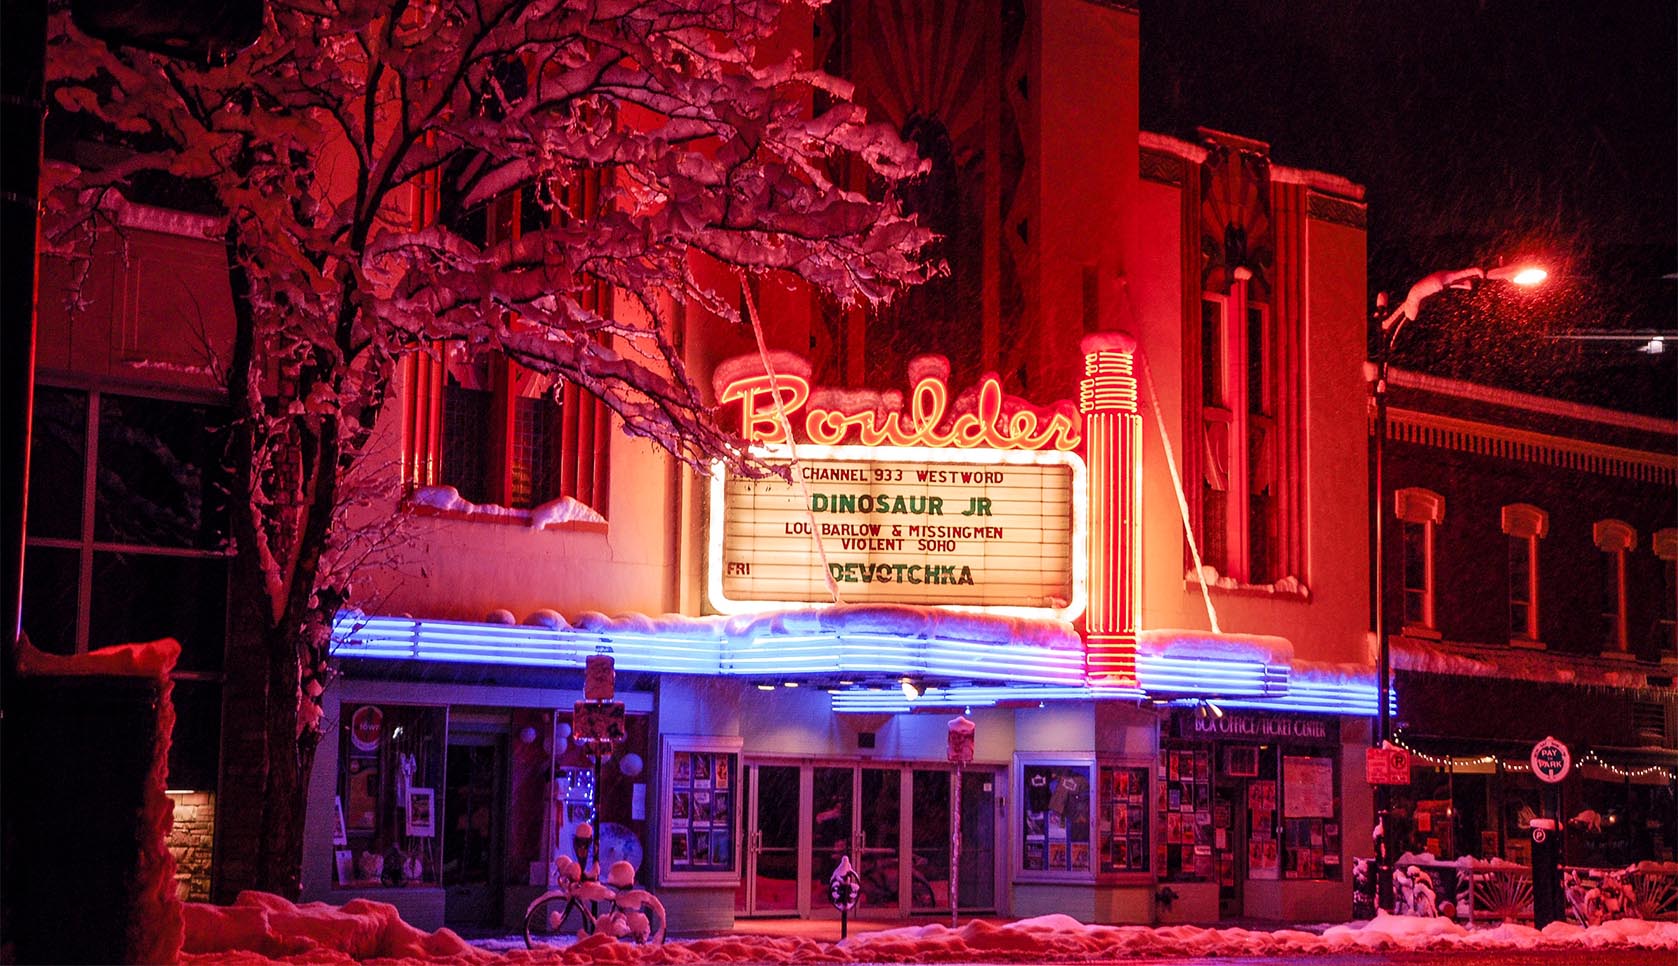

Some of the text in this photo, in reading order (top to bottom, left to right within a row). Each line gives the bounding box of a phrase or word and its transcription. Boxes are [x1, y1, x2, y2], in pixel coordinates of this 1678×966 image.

[722, 373, 1081, 450] Boulder
[802, 467, 867, 482] CHANNEL
[875, 469, 903, 482] 933
[917, 470, 1004, 484] WESTWORD
[812, 493, 993, 516] DINOSAUR JR
[785, 522, 812, 535] LOU
[822, 523, 881, 537] BARLOW
[892, 524, 902, 537] &
[841, 538, 956, 552] VIOLENT SOHO
[727, 562, 751, 576] FRI
[828, 562, 974, 586] DEVOTCHKA
[1294, 718, 1326, 737] CENTER
